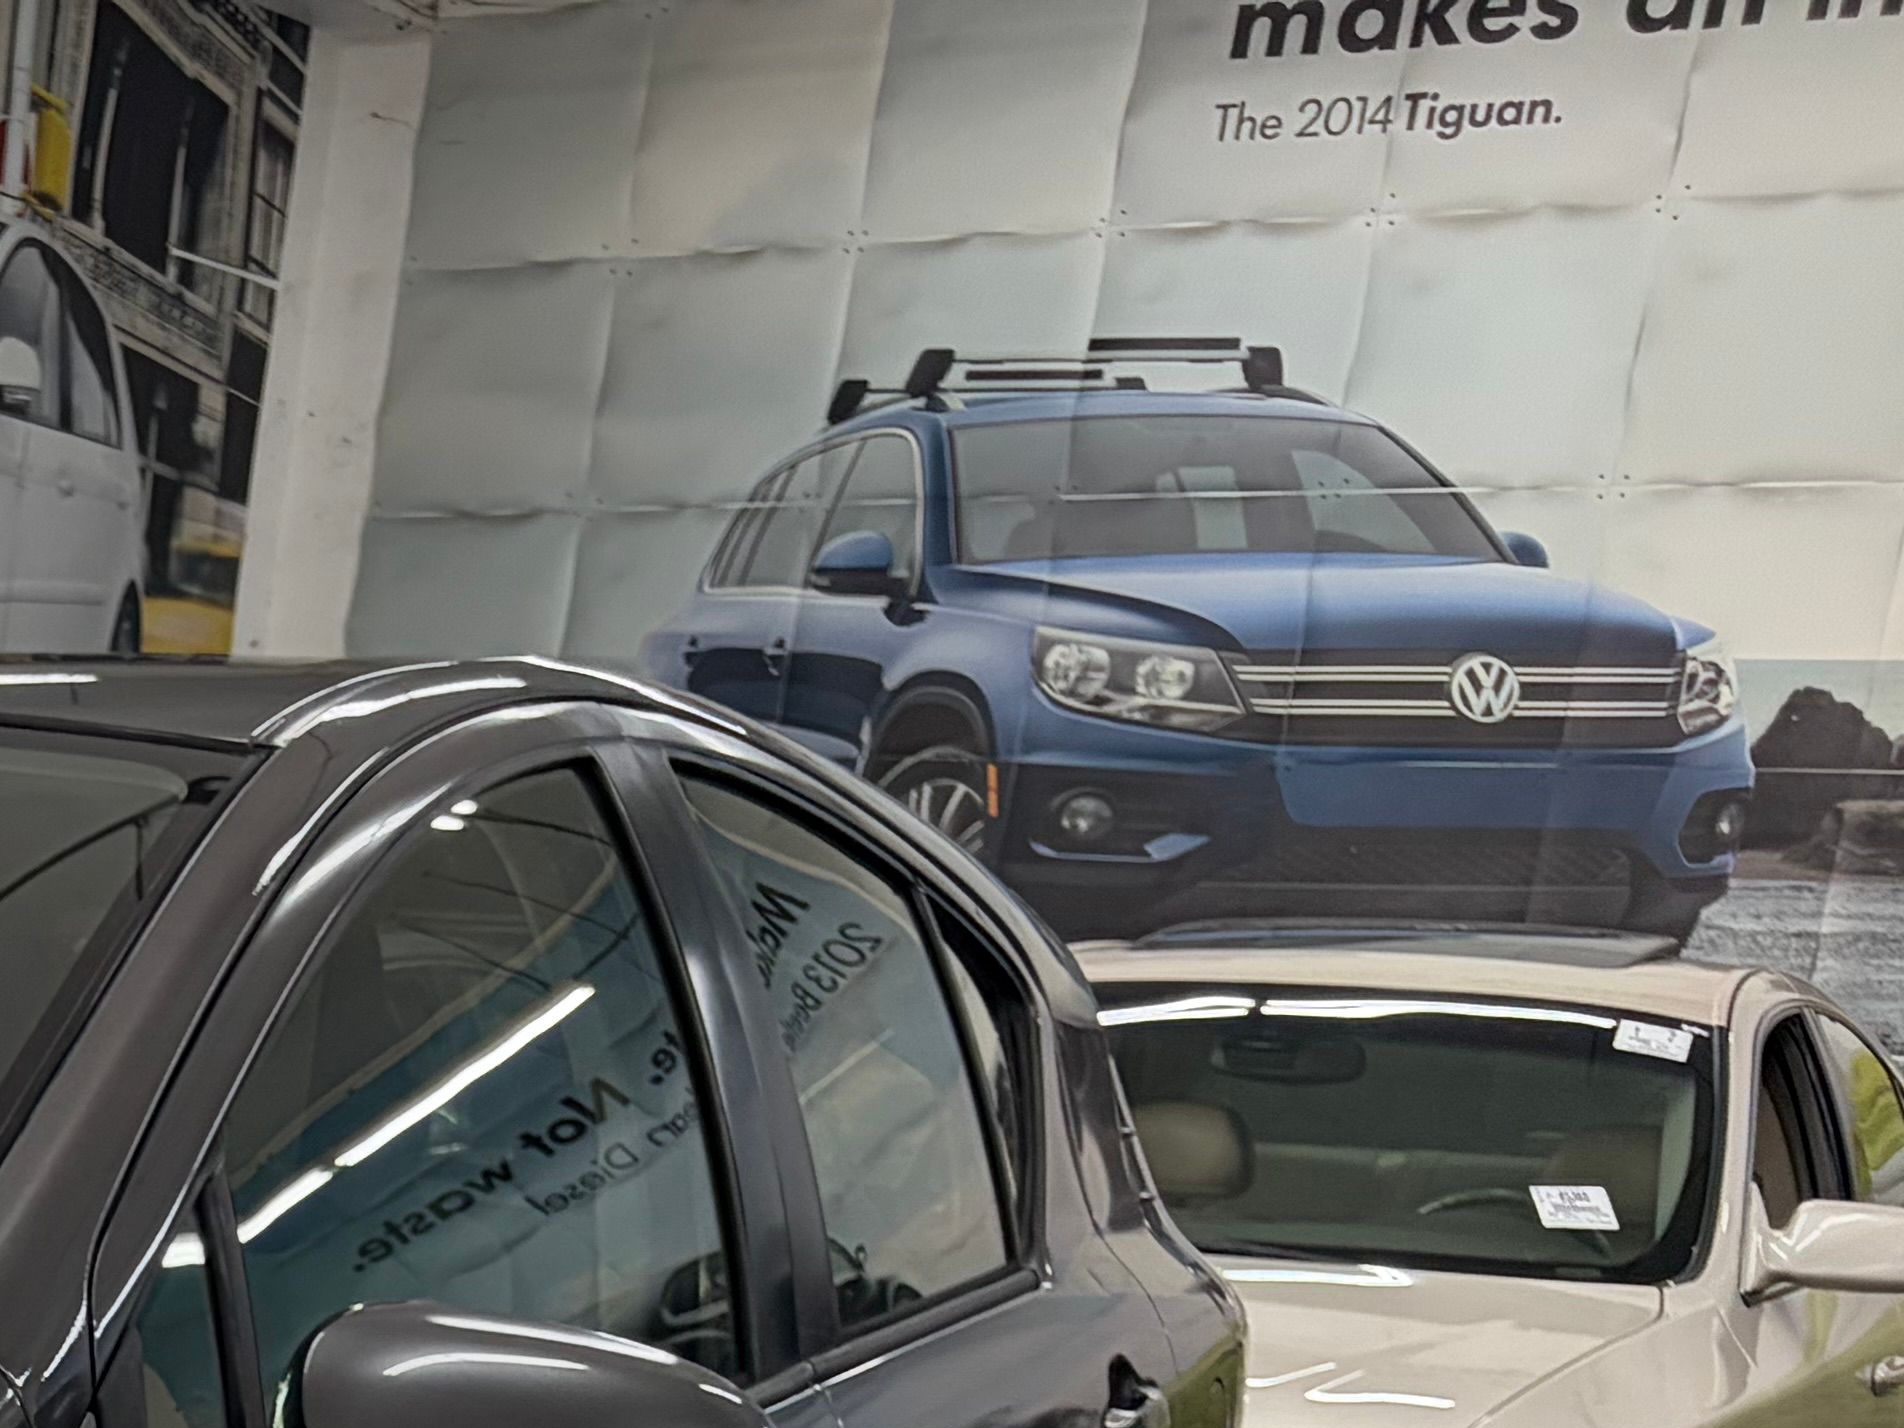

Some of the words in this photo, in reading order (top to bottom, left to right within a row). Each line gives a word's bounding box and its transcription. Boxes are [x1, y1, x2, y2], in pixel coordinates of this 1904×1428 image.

[1229, 0, 1579, 59] makes
[1215, 101, 1283, 142] The
[1294, 95, 1394, 138] 2014
[1404, 92, 1563, 139] Tiguan.
